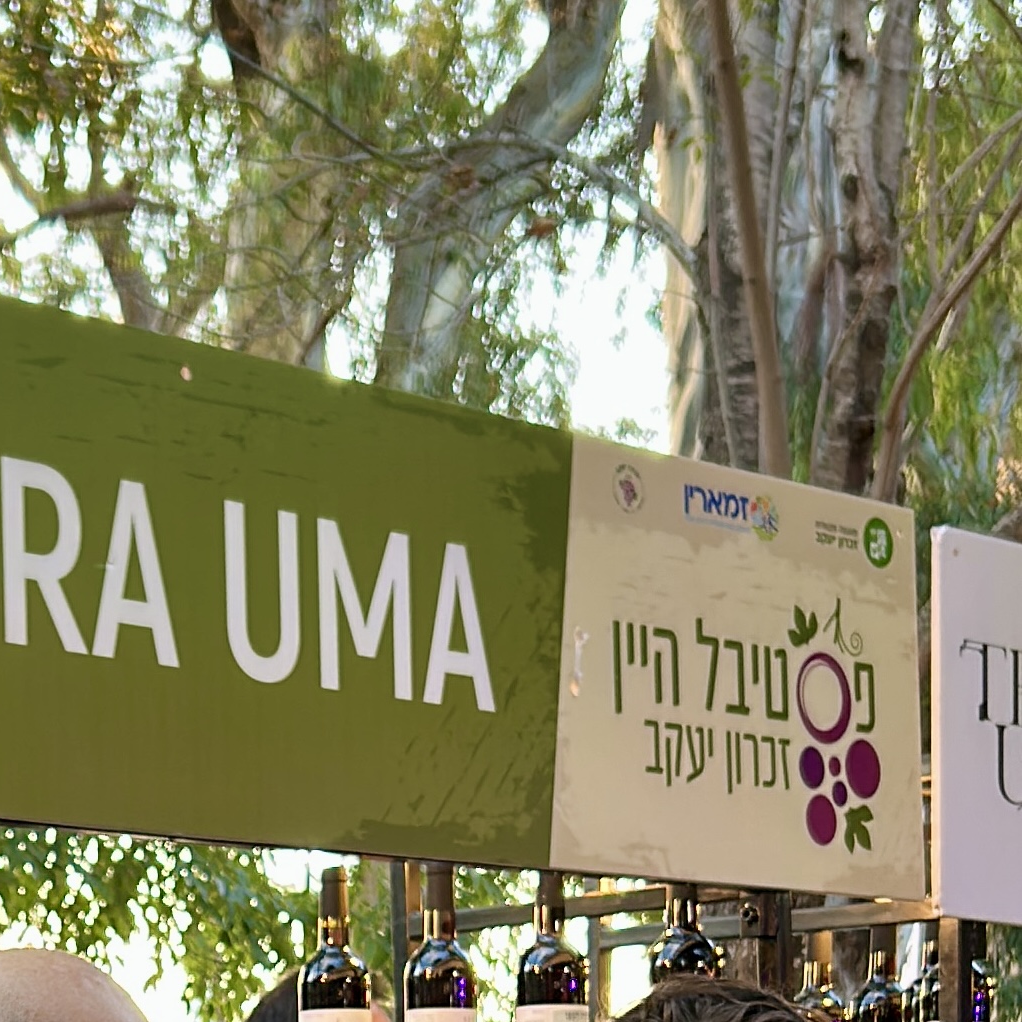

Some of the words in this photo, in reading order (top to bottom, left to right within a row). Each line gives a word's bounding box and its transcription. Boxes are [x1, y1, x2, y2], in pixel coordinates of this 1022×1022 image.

[684, 484, 749, 521] זמארין
[223, 499, 496, 713] UMA
[612, 619, 680, 714] היין
[644, 718, 714, 787] יעקב
[725, 730, 791, 795] זכרון
